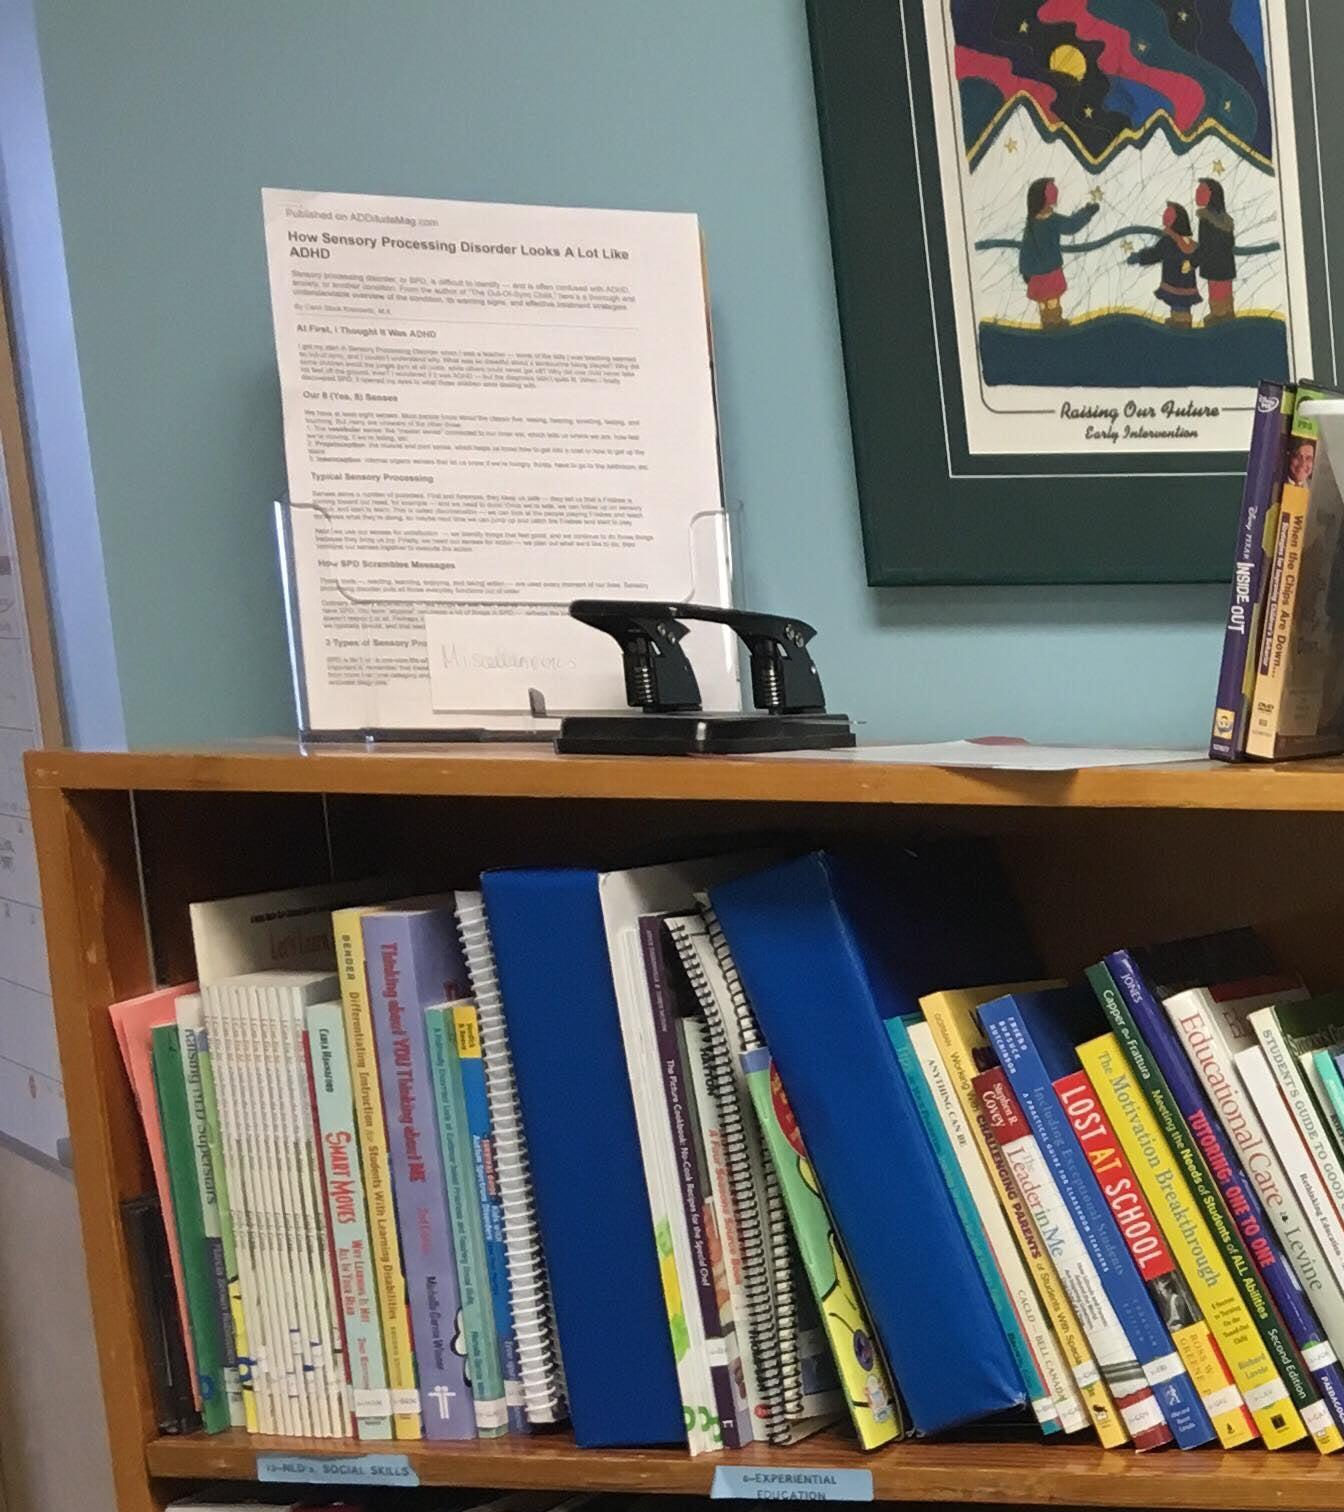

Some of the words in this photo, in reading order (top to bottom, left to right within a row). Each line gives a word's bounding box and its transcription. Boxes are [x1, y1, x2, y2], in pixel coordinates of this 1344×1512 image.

[288, 231, 318, 244] How
[321, 233, 377, 250] Sensory
[381, 237, 457, 254] Processing
[460, 241, 517, 254] Disorder
[520, 244, 560, 257] Looks
[564, 246, 575, 260] A
[577, 246, 599, 260] Lot
[602, 247, 629, 260] Like
[289, 246, 331, 261] ADHD
[1060, 401, 1119, 423] Raising
[1123, 402, 1157, 419] Our
[1161, 401, 1220, 418] Future
[1085, 426, 1118, 444] Early
[1121, 426, 1198, 438] Intervention
[1235, 561, 1255, 602] INSIDE
[1228, 605, 1246, 634] OUT
[1061, 1085, 1105, 1143] LOST
[1088, 1147, 1122, 1173] AT
[1105, 1178, 1162, 1270] SCHOOL
[370, 1466, 410, 1477] SKILLS
